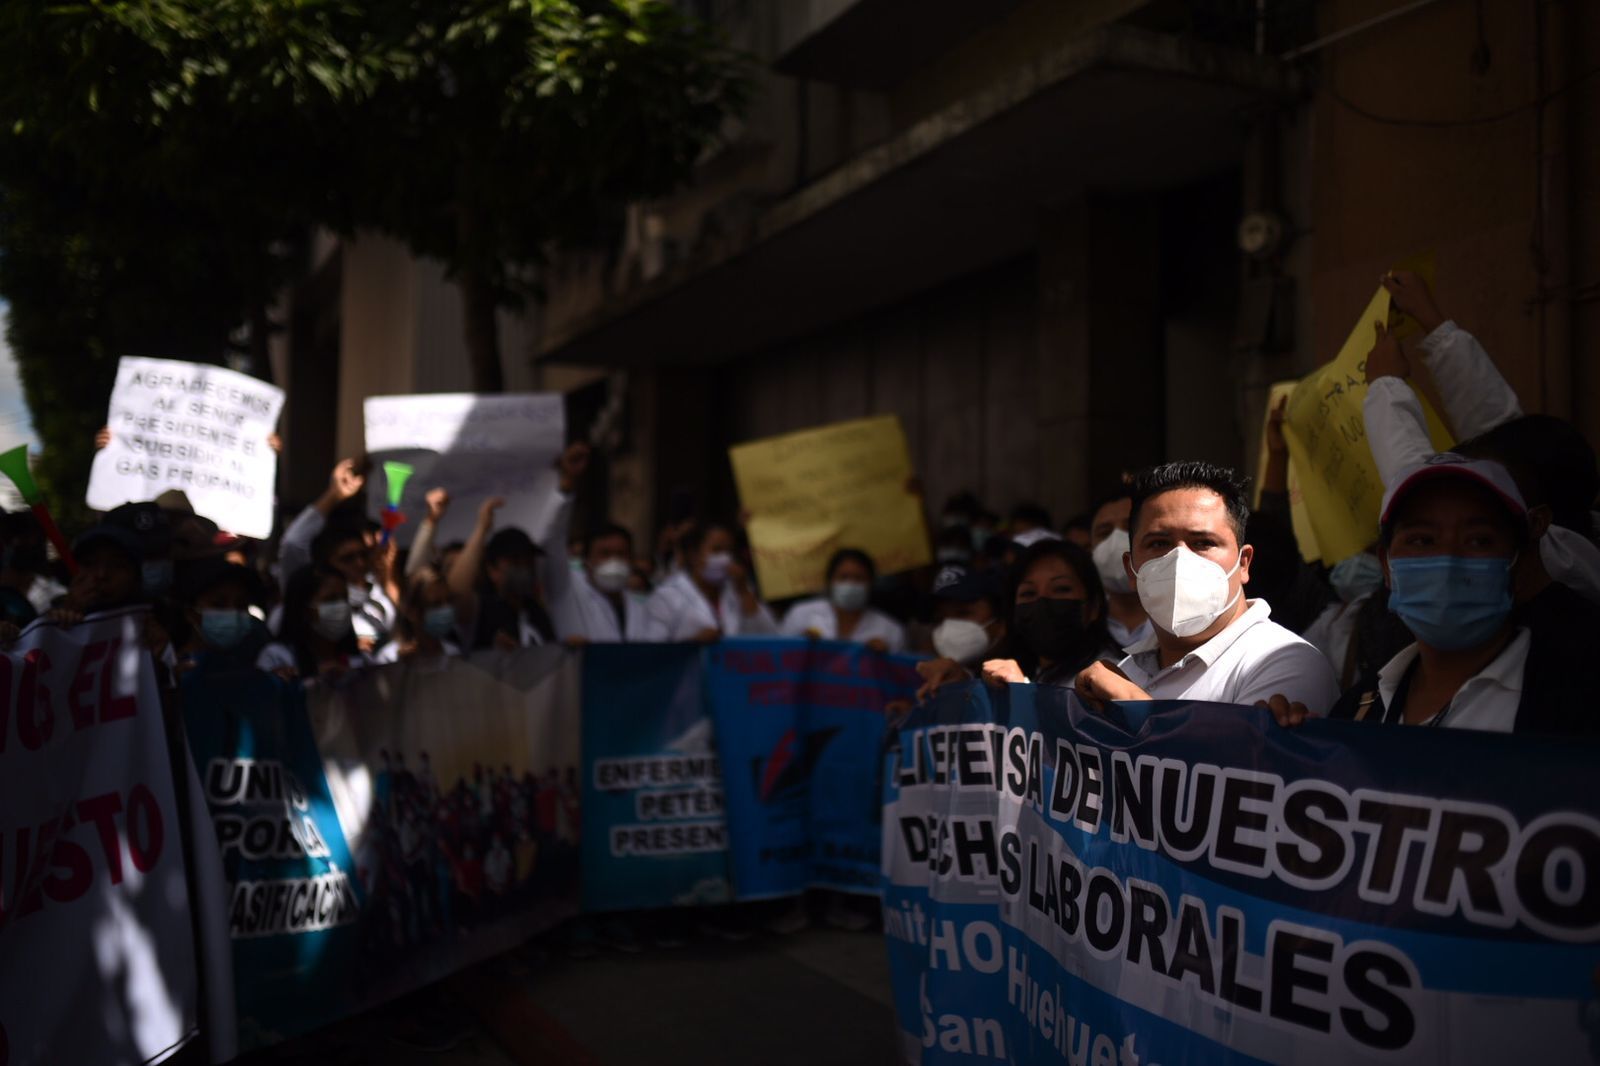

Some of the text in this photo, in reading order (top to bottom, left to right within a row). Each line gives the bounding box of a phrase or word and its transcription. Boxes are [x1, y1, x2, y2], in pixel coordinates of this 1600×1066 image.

[128, 369, 272, 417] AGRADECEMOS
[153, 396, 177, 412] AL
[122, 408, 238, 447] PRESIDENTE
[130, 434, 223, 467] SUBSIDIO
[115, 455, 257, 499] GAS PROPANO
[69, 637, 137, 731] EL
[615, 824, 728, 852] PRESEN
[1051, 745, 1102, 826] DE
[1112, 759, 1600, 932] NUESTRO
[1029, 843, 1416, 1050] LABORALES
[1008, 945, 1162, 1066] Huehuet
